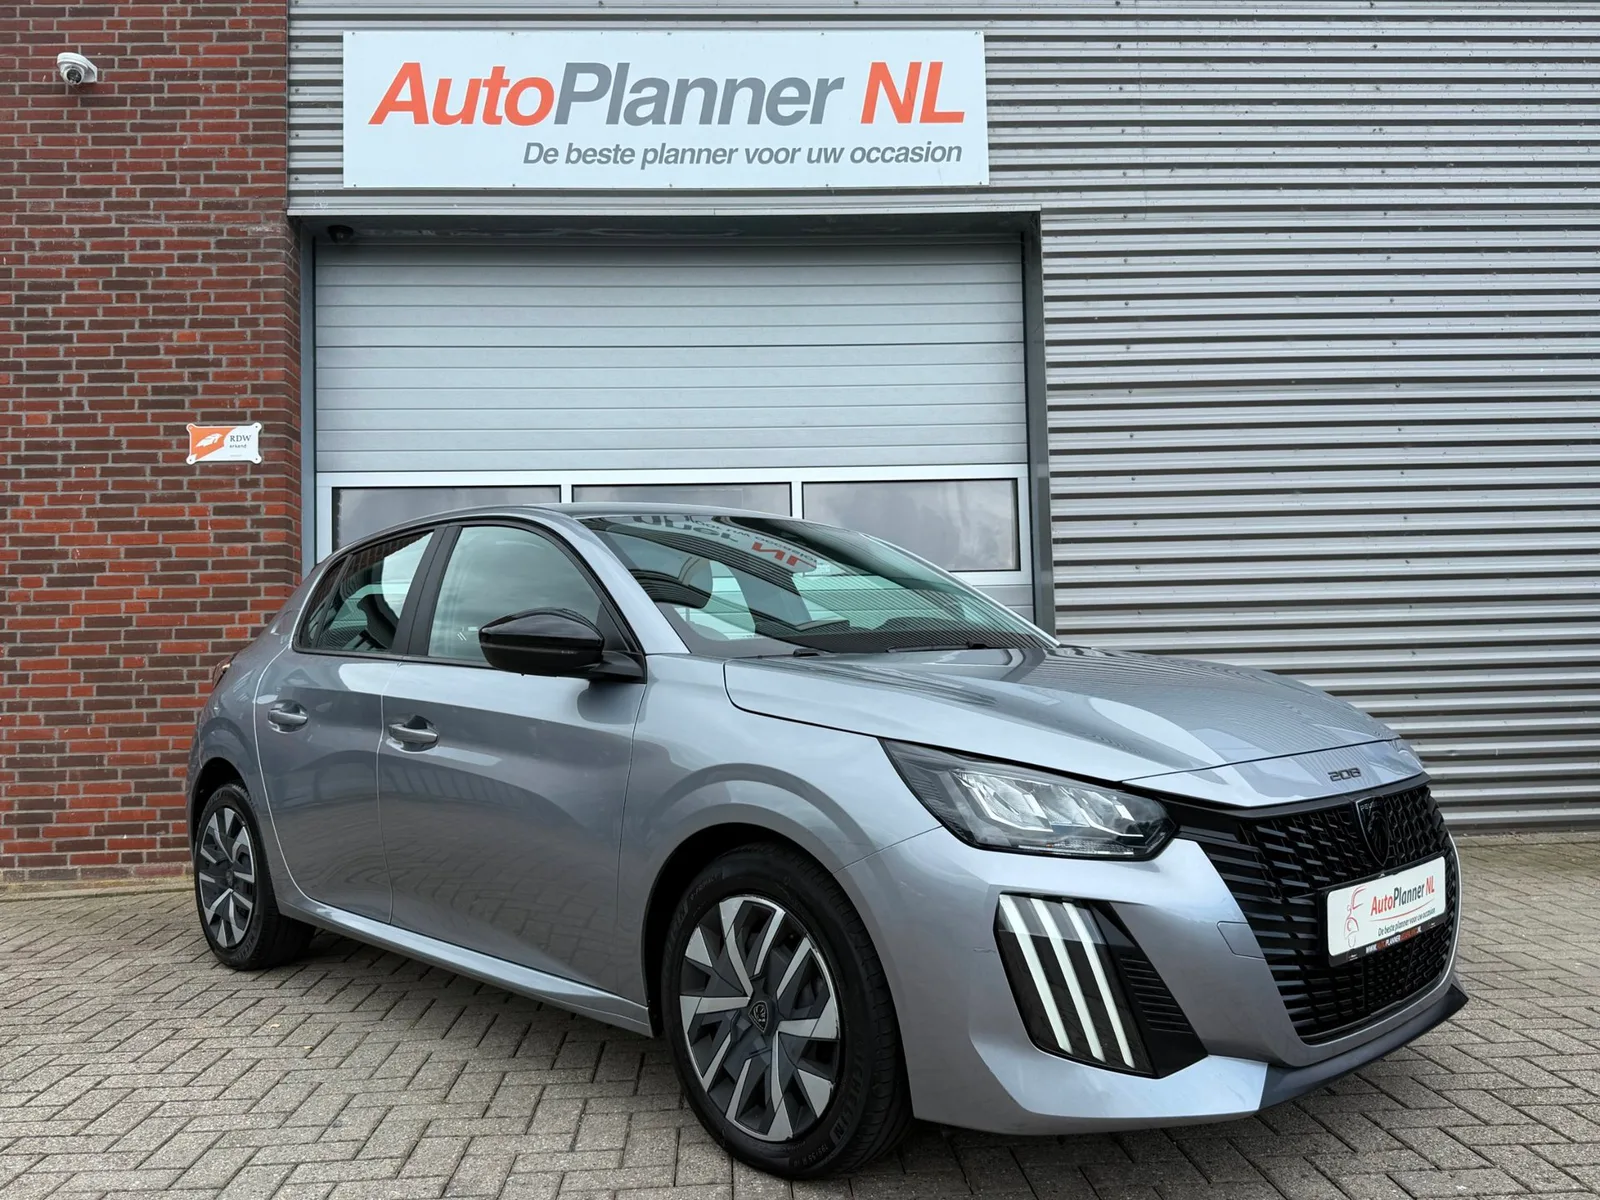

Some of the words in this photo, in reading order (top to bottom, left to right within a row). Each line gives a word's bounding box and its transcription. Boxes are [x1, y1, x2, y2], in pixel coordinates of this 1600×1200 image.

[368, 62, 845, 126] AutoPlanner
[860, 61, 965, 124] NL
[523, 142, 558, 165] De
[564, 143, 635, 165] beste
[640, 143, 738, 170] planner
[744, 147, 801, 165] voor
[806, 146, 844, 164] uw
[849, 141, 962, 164] occasion
[229, 434, 252, 442] RDW
[1327, 767, 1361, 781] 208
[1370, 883, 1425, 916] AutoPlanner
[1425, 876, 1435, 896] NL
